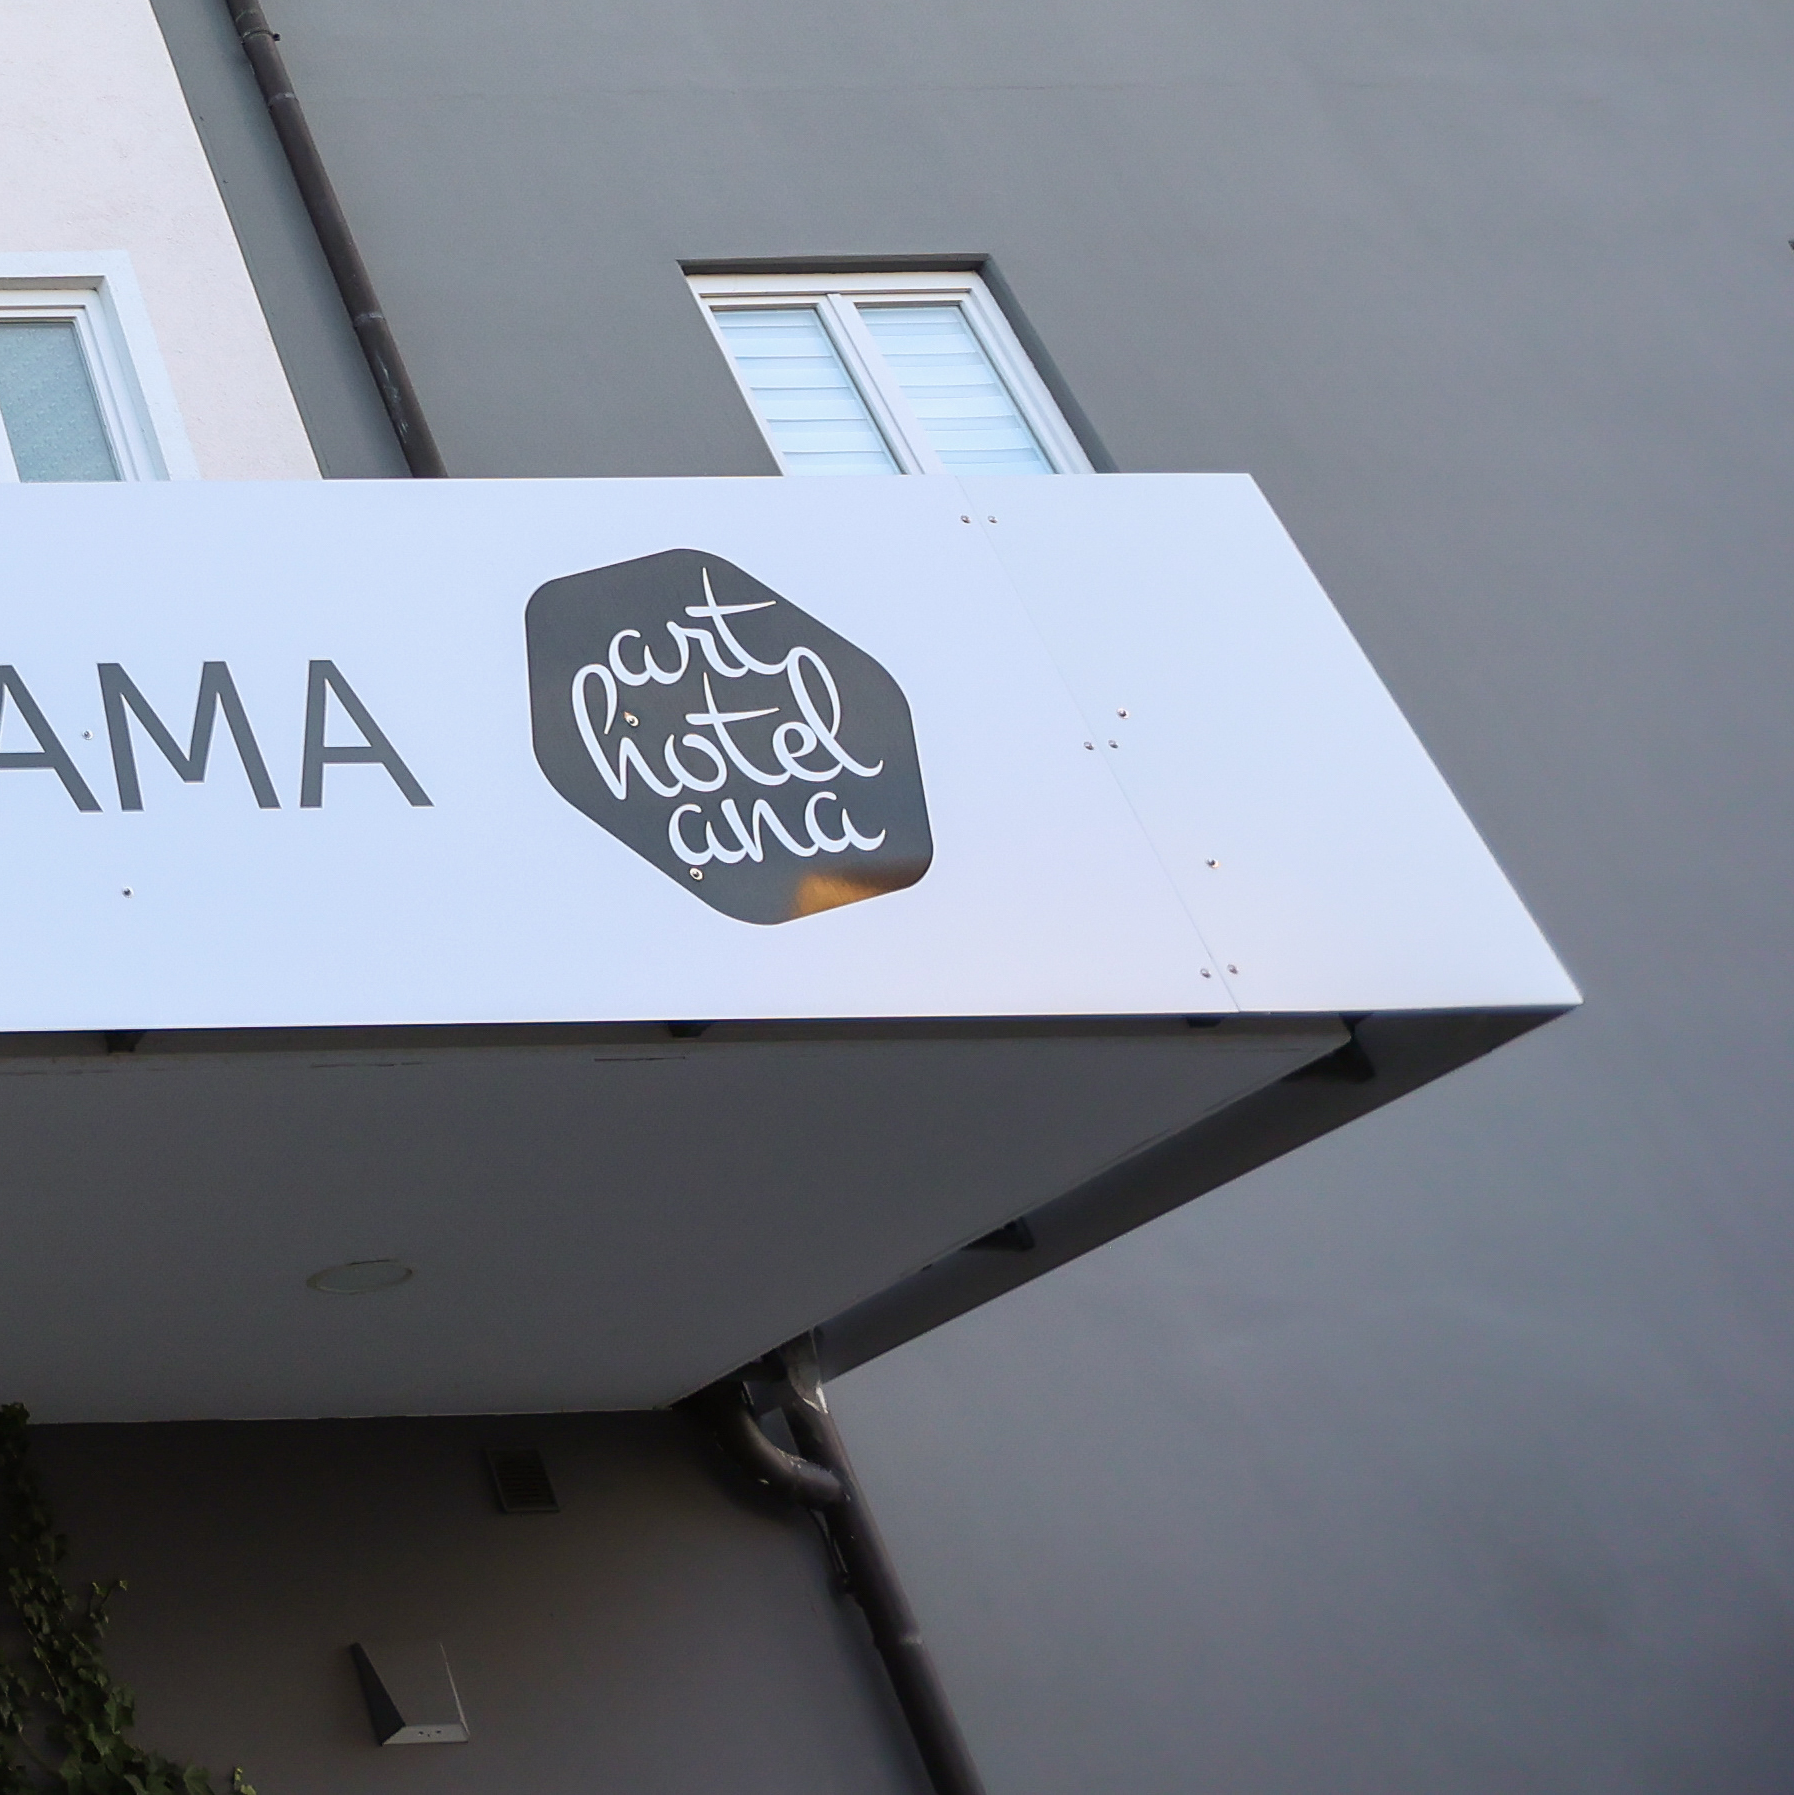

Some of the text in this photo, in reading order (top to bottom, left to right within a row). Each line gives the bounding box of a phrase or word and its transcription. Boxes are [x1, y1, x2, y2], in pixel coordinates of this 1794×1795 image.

[608, 566, 788, 687] art
[571, 645, 885, 800] hotel
[667, 790, 887, 866] ana
